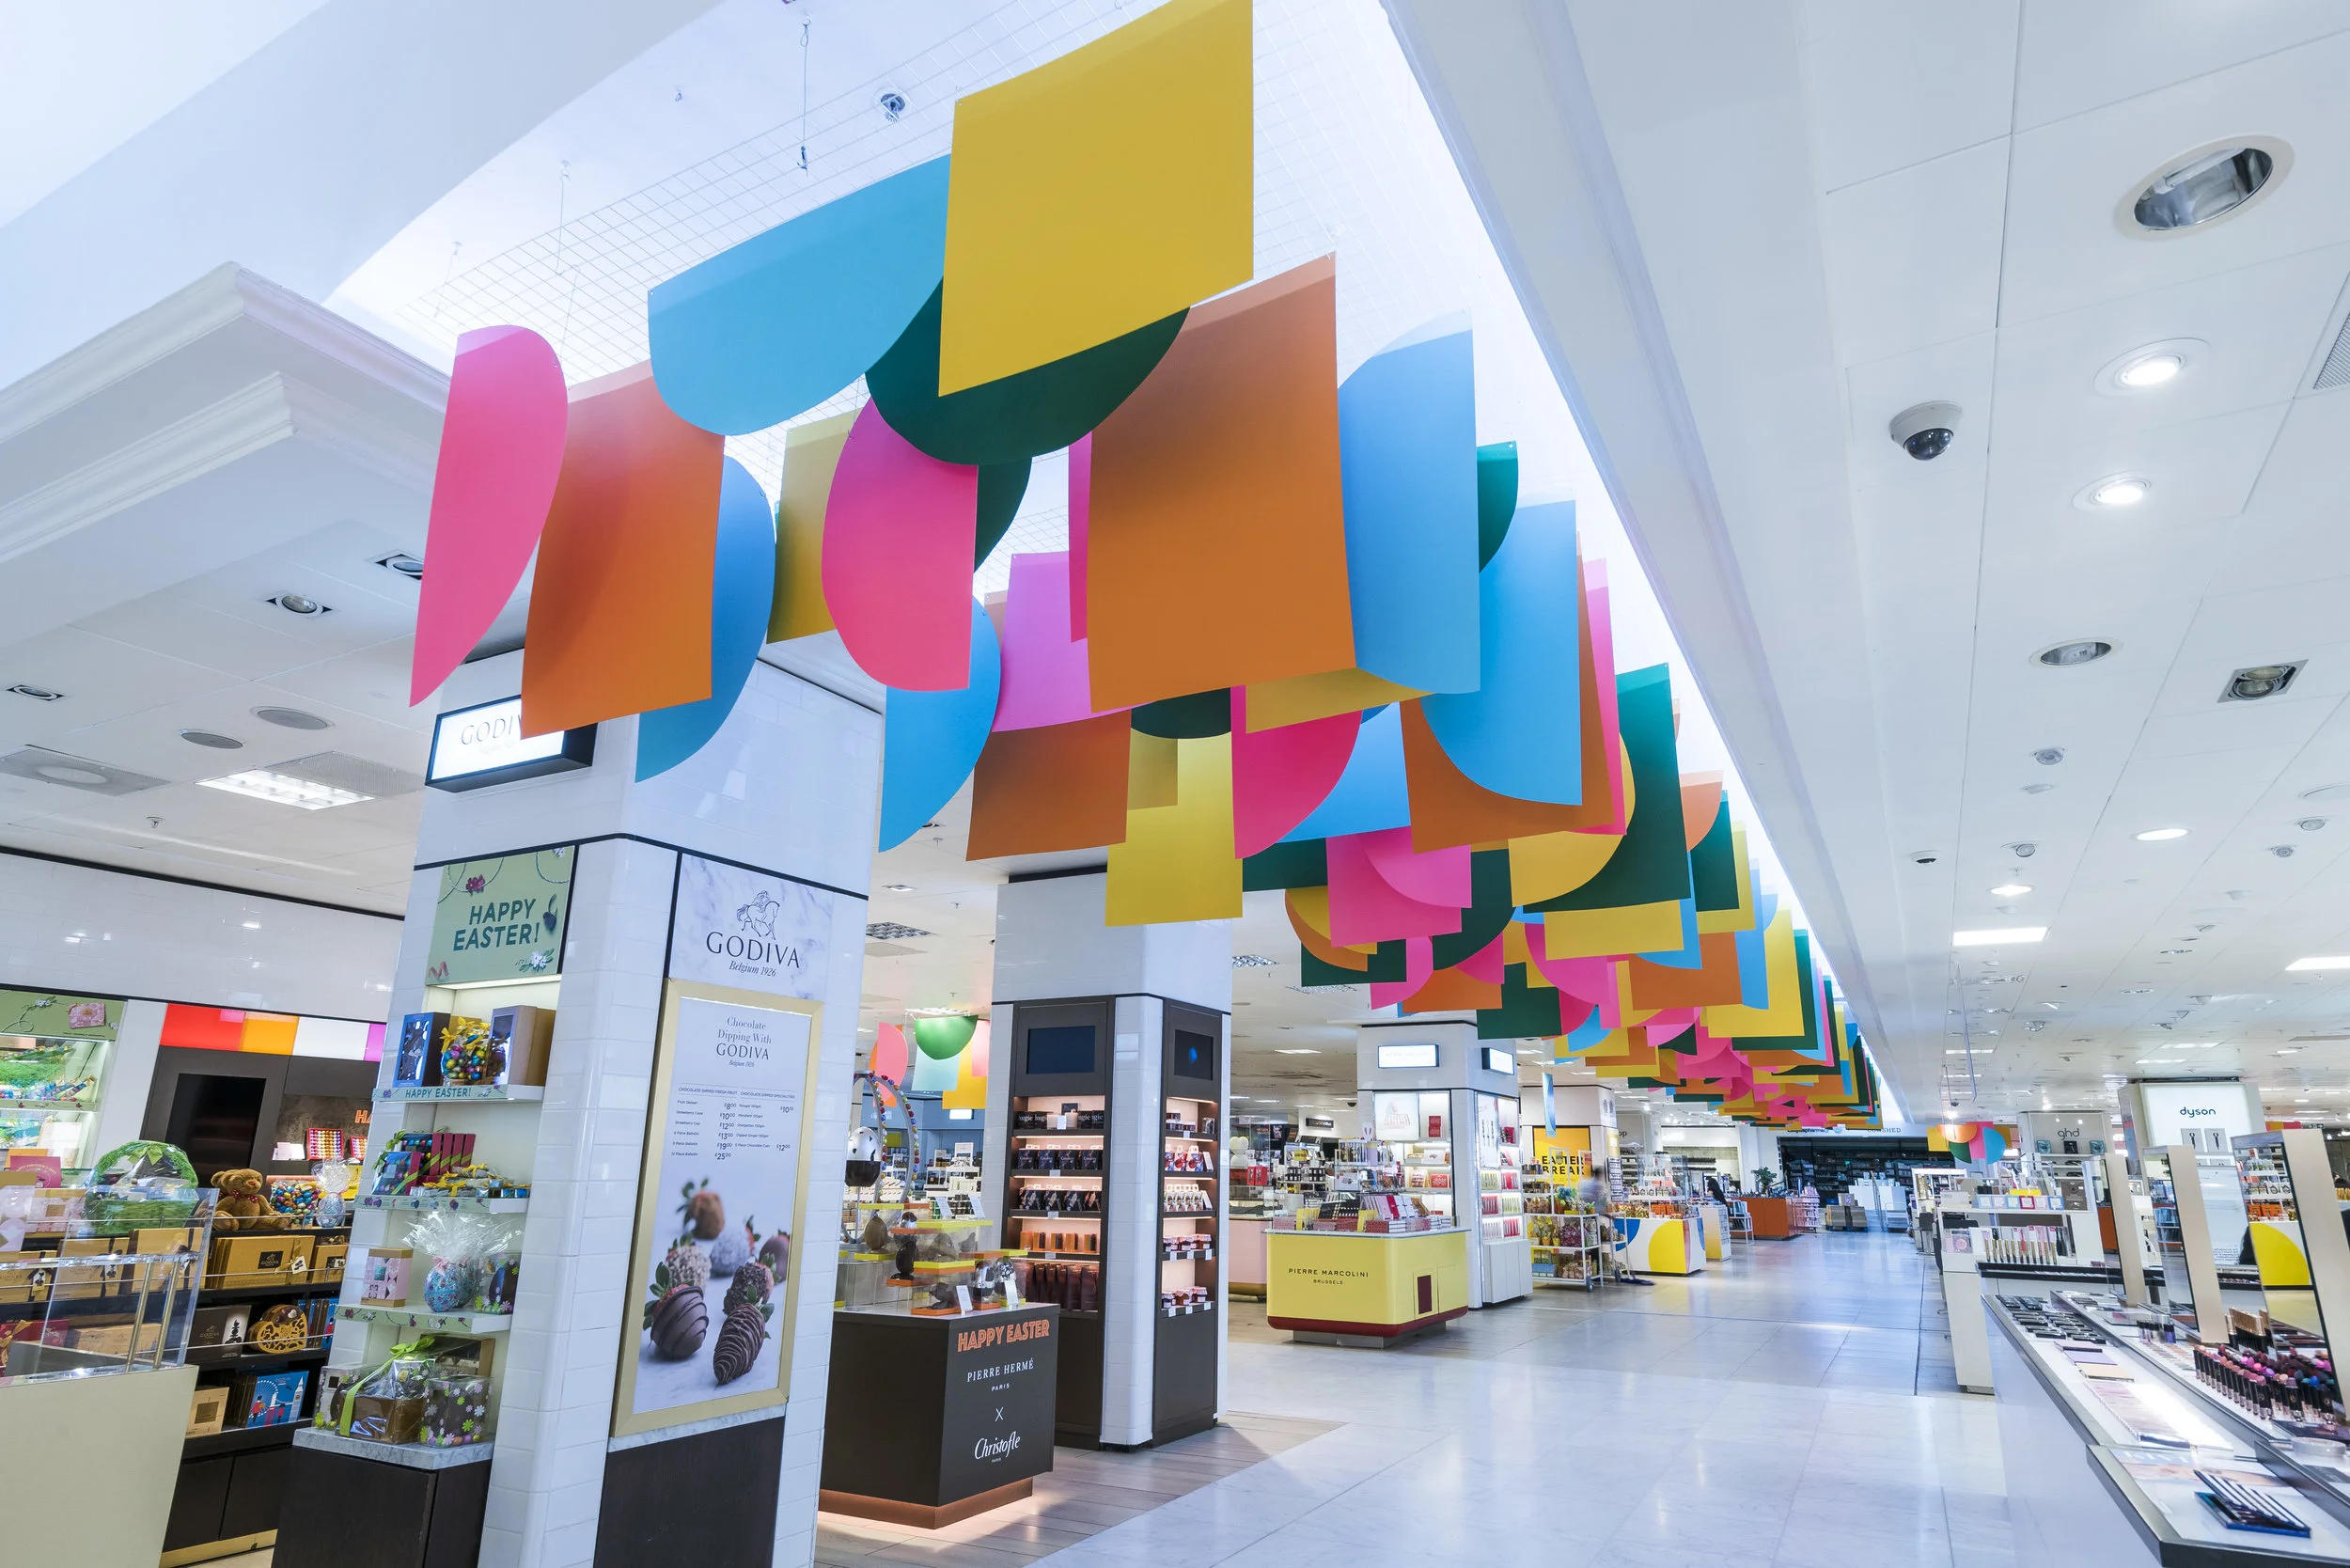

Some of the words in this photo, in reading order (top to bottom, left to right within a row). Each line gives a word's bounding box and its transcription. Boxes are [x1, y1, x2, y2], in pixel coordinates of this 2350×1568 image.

[461, 713, 522, 745] GODI
[469, 899, 536, 925] HAPPY
[453, 923, 540, 951] EASTER!
[706, 932, 799, 968] GODIVA
[729, 960, 759, 973] Belgium
[761, 967, 776, 977] 1926
[727, 1017, 766, 1029] Chocolate
[718, 1029, 751, 1043] Dipping
[753, 1033, 771, 1043] With
[716, 1043, 768, 1060] GODIVA
[405, 1089, 432, 1098] HAPPY
[435, 1088, 471, 1098] EASTER!
[2179, 1106, 2216, 1118] dyson
[2058, 1128, 2080, 1140] ghd
[1542, 1156, 1584, 1165] EATER
[1542, 1166, 1584, 1175] BREAK
[957, 1326, 1004, 1352] HAPPY
[1006, 1319, 1050, 1343] EASTER
[967, 1366, 1001, 1382] PIERRE
[1004, 1358, 1034, 1374] HERMÉ
[991, 1383, 1010, 1392] PARIS
[995, 1407, 1003, 1421] X
[974, 1431, 1020, 1459] Christofle
